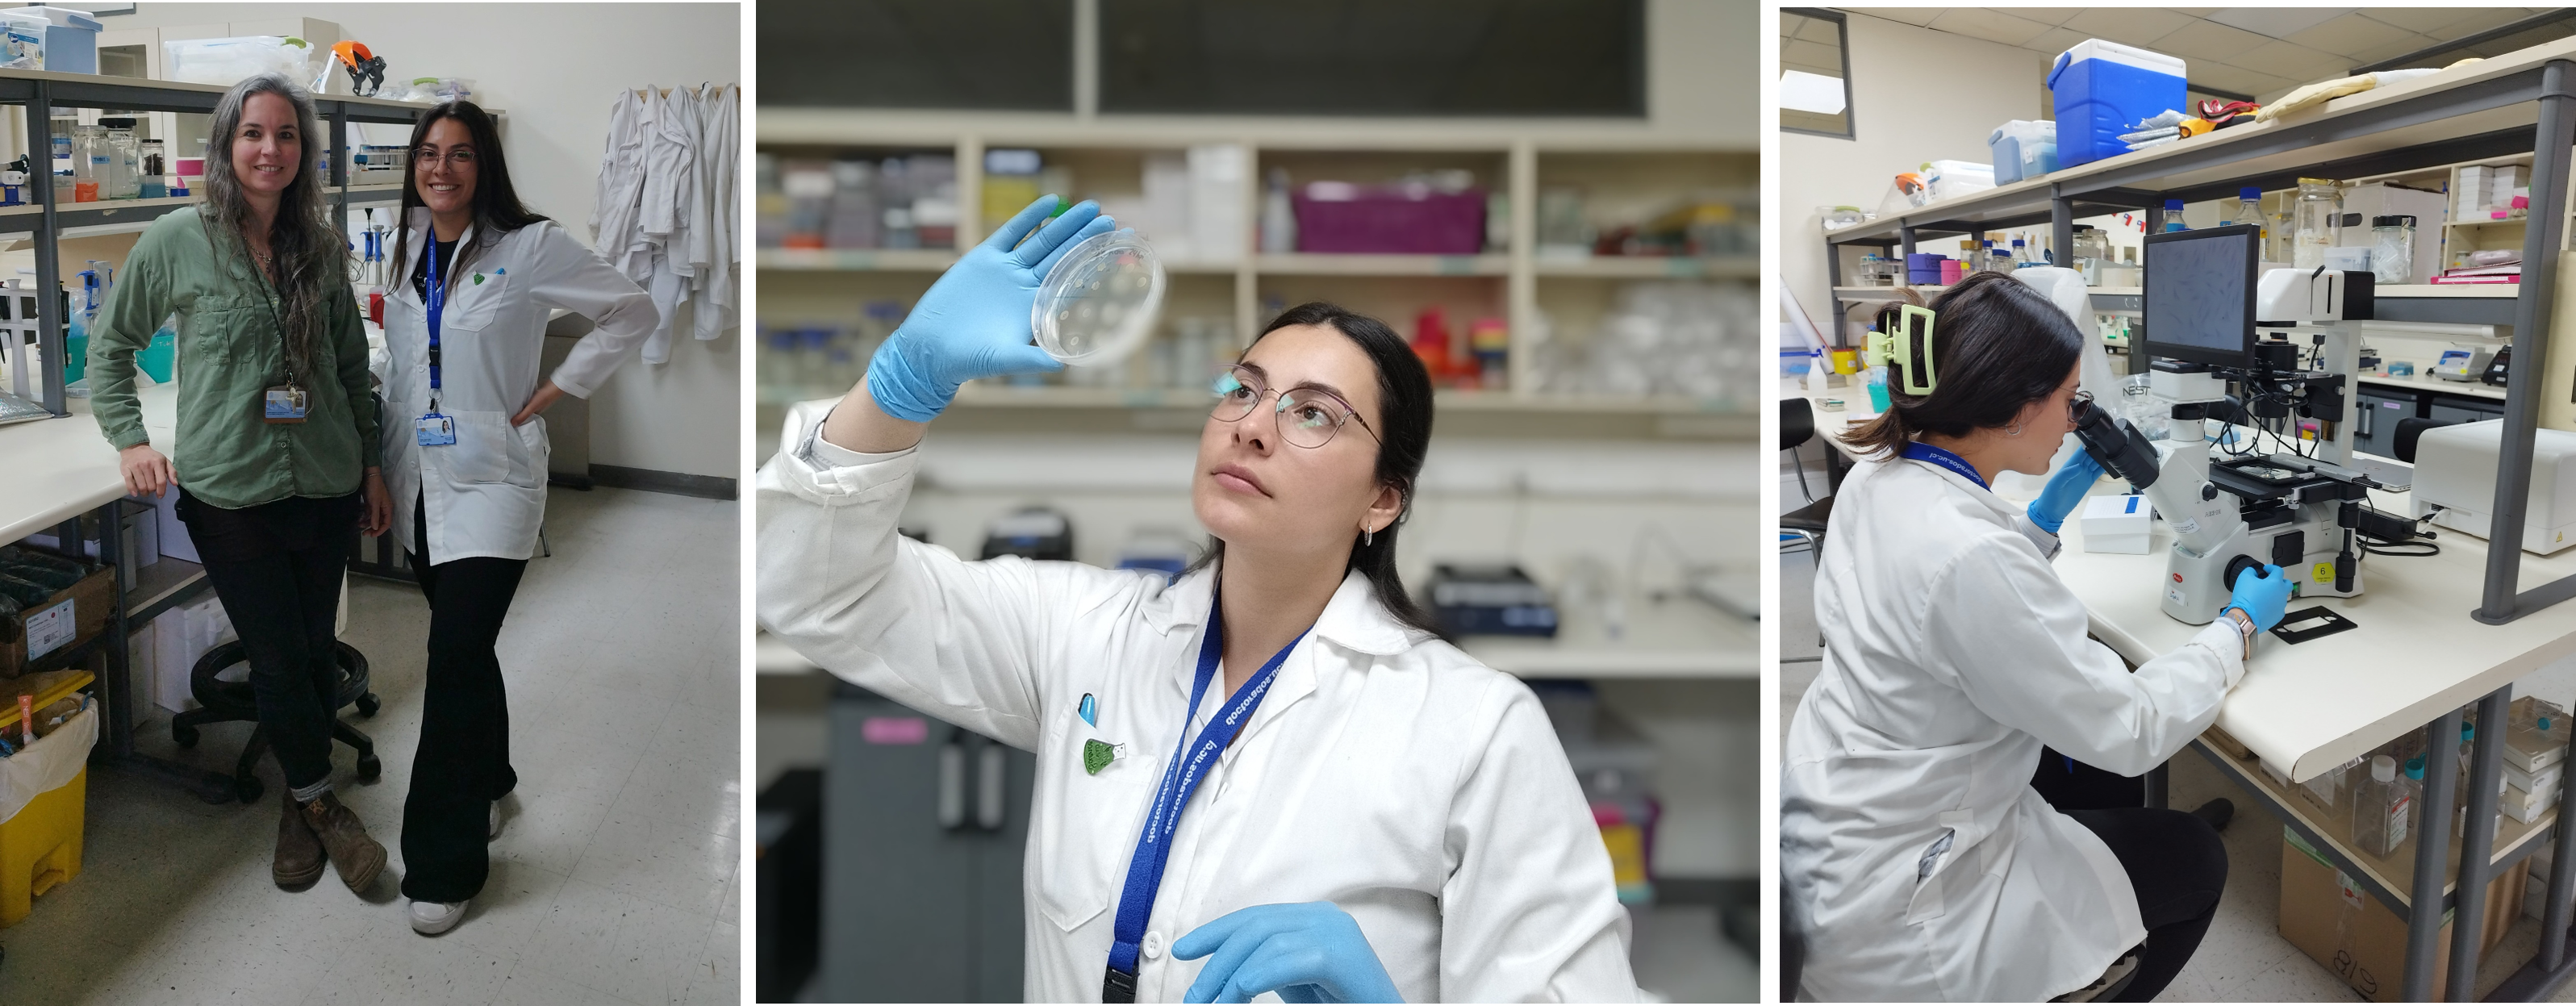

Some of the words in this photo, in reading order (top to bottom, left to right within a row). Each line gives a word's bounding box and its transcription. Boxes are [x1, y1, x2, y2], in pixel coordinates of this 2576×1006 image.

[2123, 386, 2152, 397] NEST
[1929, 453, 1982, 482] doctorados.uc.cl
[2320, 567, 2326, 575] 6
